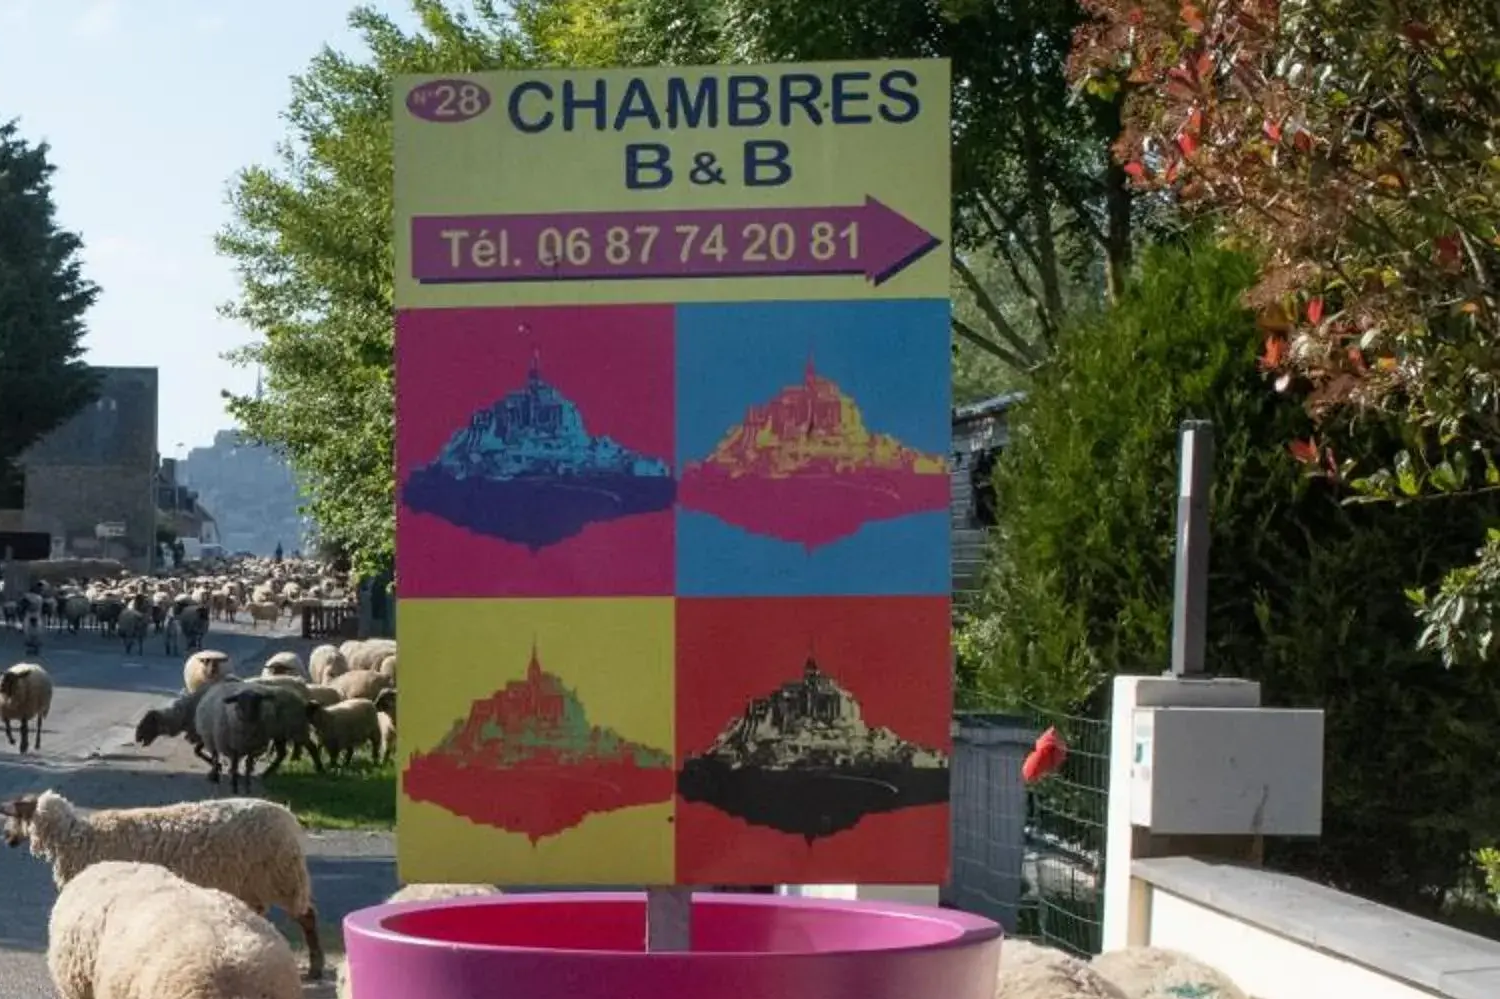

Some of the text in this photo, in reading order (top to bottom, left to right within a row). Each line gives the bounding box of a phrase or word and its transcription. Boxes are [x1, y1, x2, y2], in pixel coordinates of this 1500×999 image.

[435, 84, 482, 116] 28
[507, 69, 921, 134] CHAMBRES
[624, 139, 793, 190] B & B
[440, 221, 860, 268] Tél. 06 87 74 20 81
